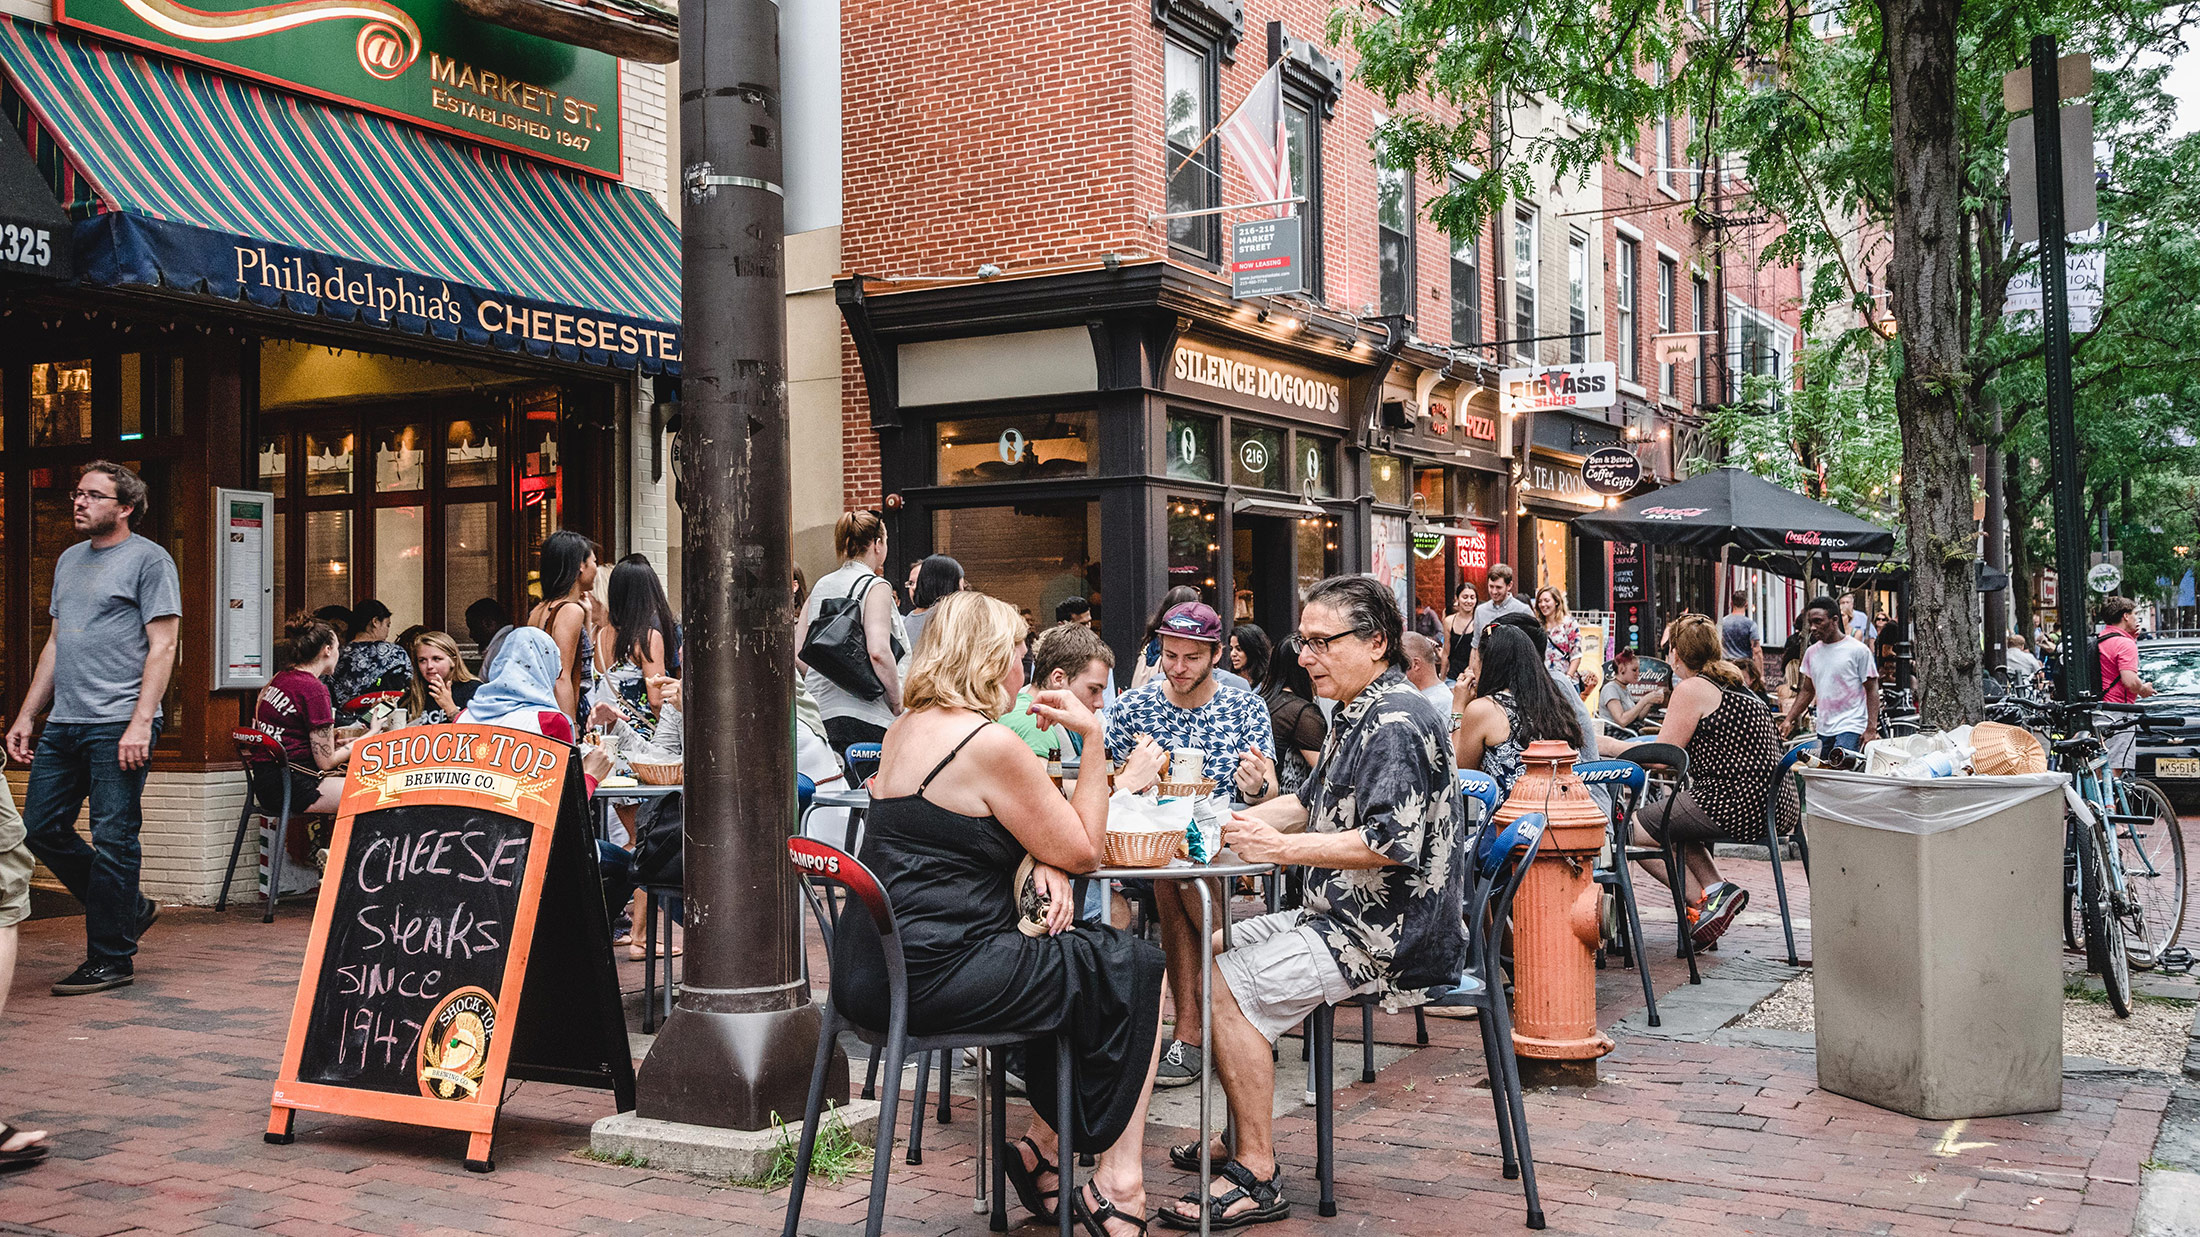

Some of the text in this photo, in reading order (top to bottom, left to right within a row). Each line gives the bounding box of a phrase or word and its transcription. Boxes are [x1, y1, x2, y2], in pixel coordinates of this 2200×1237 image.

[429, 51, 557, 116] MARKET
[563, 96, 602, 132] ST.
[432, 87, 591, 152] ESTABLISHED 1947
[1239, 225, 1275, 236] 216-218
[1239, 233, 1275, 244] MARKET
[1239, 242, 1272, 253] STREET
[1255, 259, 1281, 268] LEASING
[233, 246, 683, 363] Philadelphia's CHEESESTE
[1174, 347, 1340, 414] SILENCE DOGOOD'S
[1562, 376, 1606, 394] ASS
[1535, 395, 1577, 408] SLICES
[1466, 415, 1496, 441] PIZZA
[1245, 448, 1263, 464] 216
[1534, 466, 1555, 491] TEA
[1586, 468, 1615, 481] Coffee
[1611, 476, 1634, 489] Gifts
[232, 732, 263, 743] CAMPO'S
[361, 732, 558, 779] SHOCK TOP
[405, 771, 496, 790] BREWING CO.
[358, 829, 529, 893] CHEESE
[789, 848, 840, 873] CAMPO'S
[439, 996, 496, 1041] SHOCK TOP
[338, 1008, 423, 1074] 1947
[431, 1069, 460, 1081] BREWING
